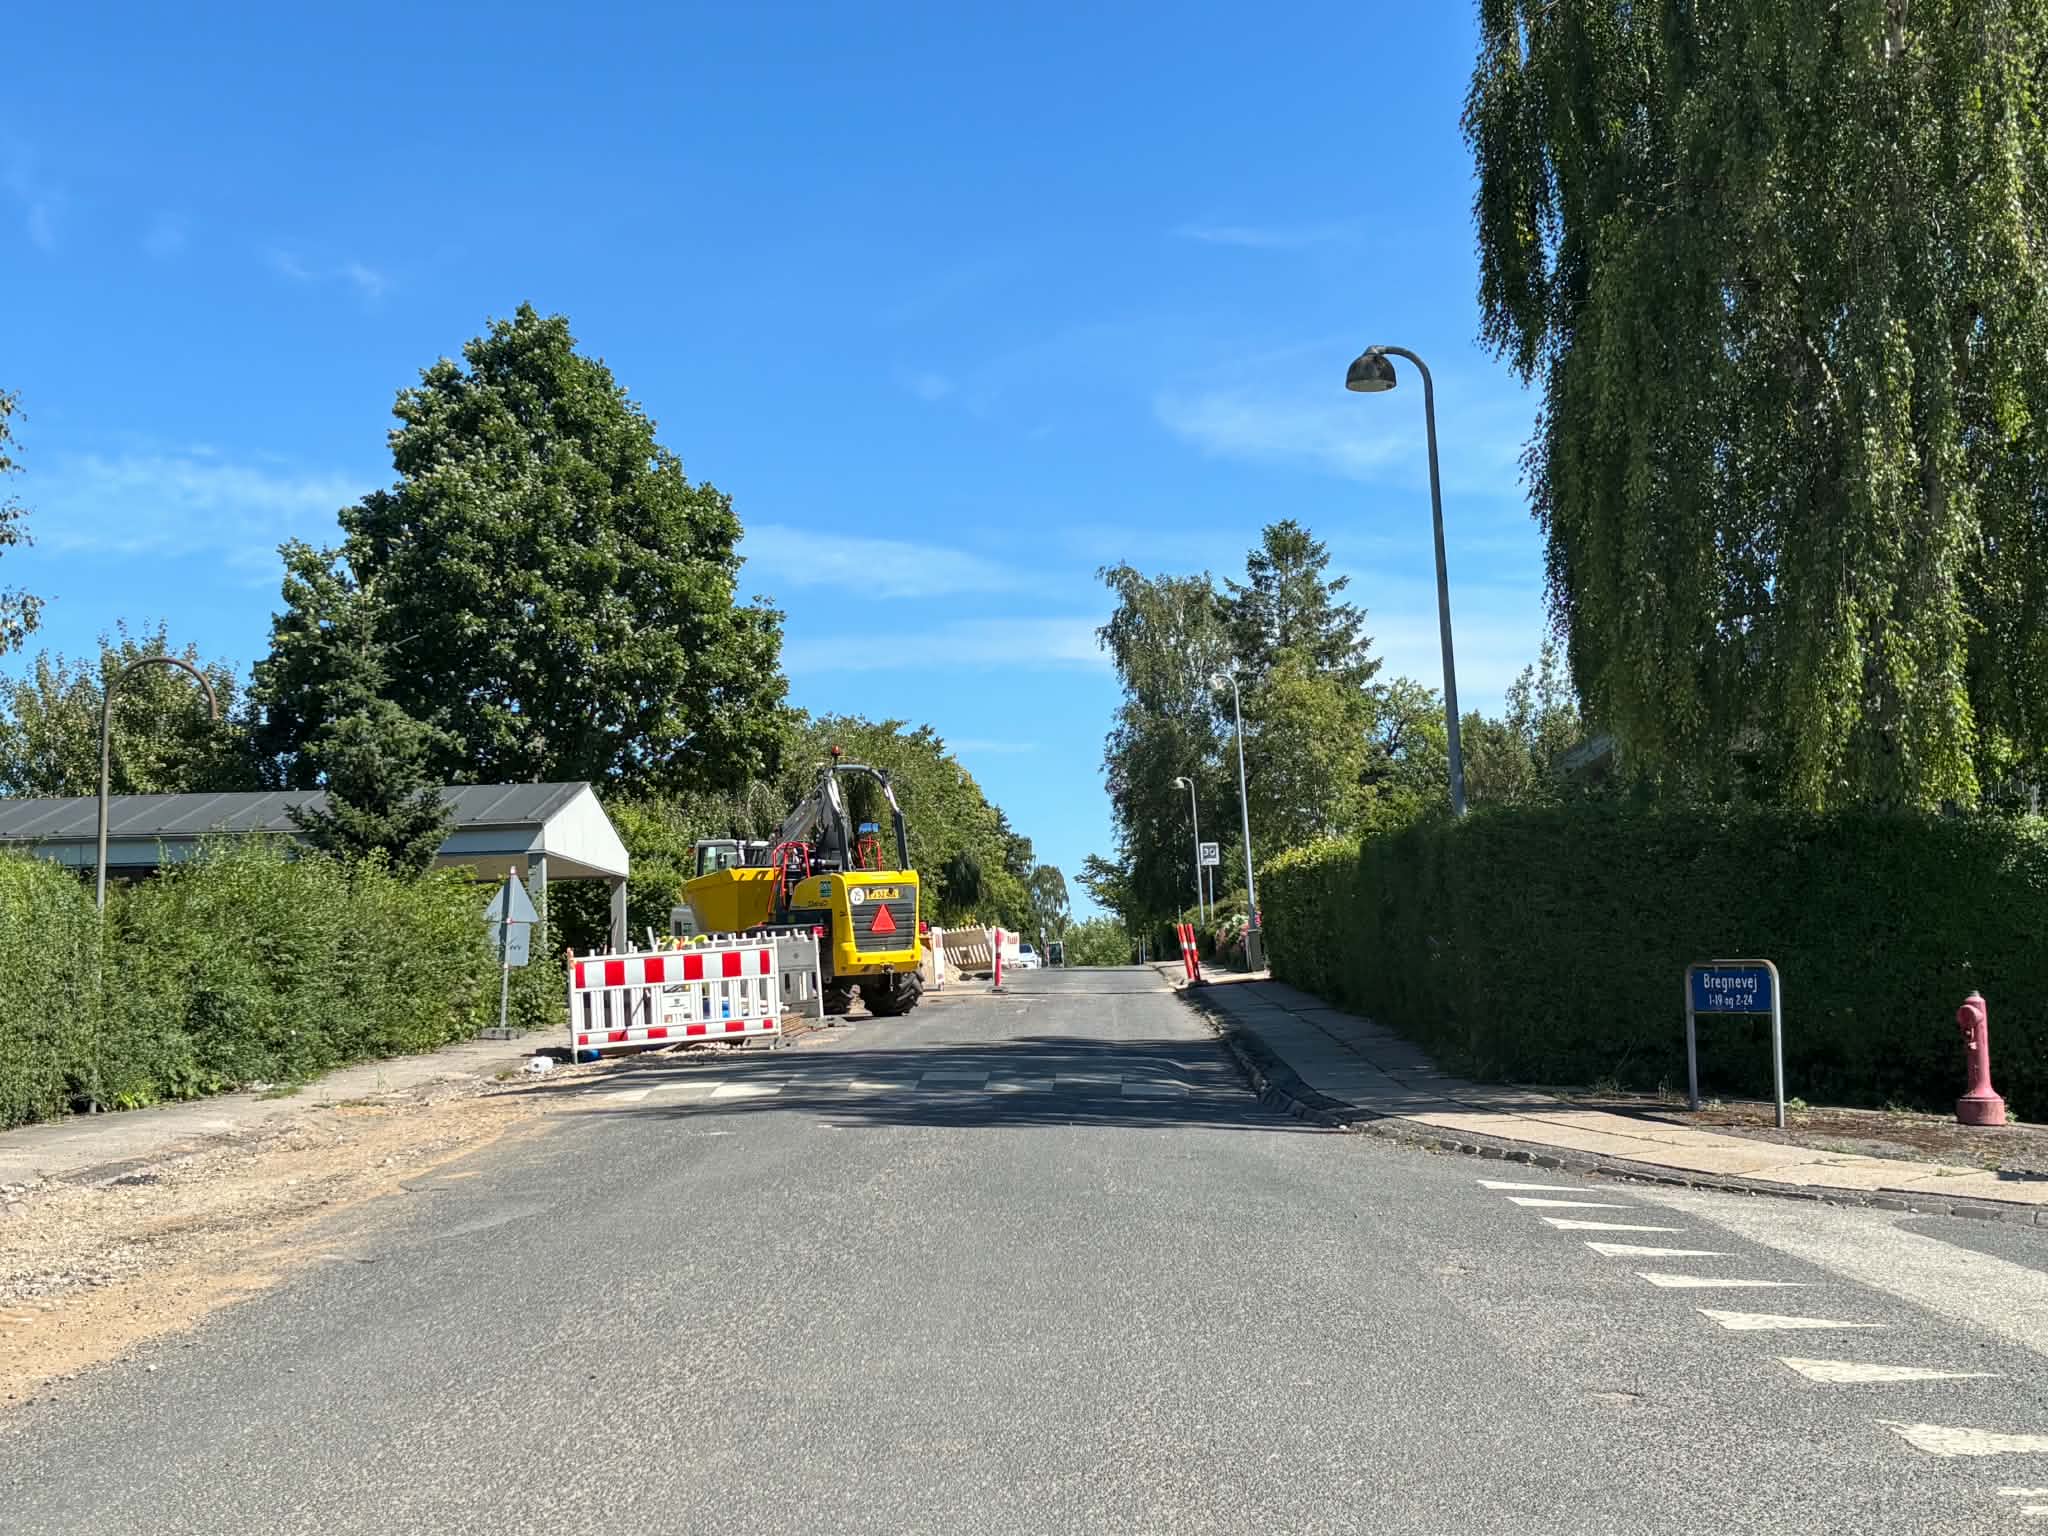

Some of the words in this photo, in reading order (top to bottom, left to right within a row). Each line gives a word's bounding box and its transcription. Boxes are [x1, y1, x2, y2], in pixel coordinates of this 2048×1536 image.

[1703, 973, 1757, 993] Bregnevej
[1709, 994, 1722, 1006] 1-19
[1724, 997, 1734, 1009] og
[1735, 994, 1753, 1006] 2-24
